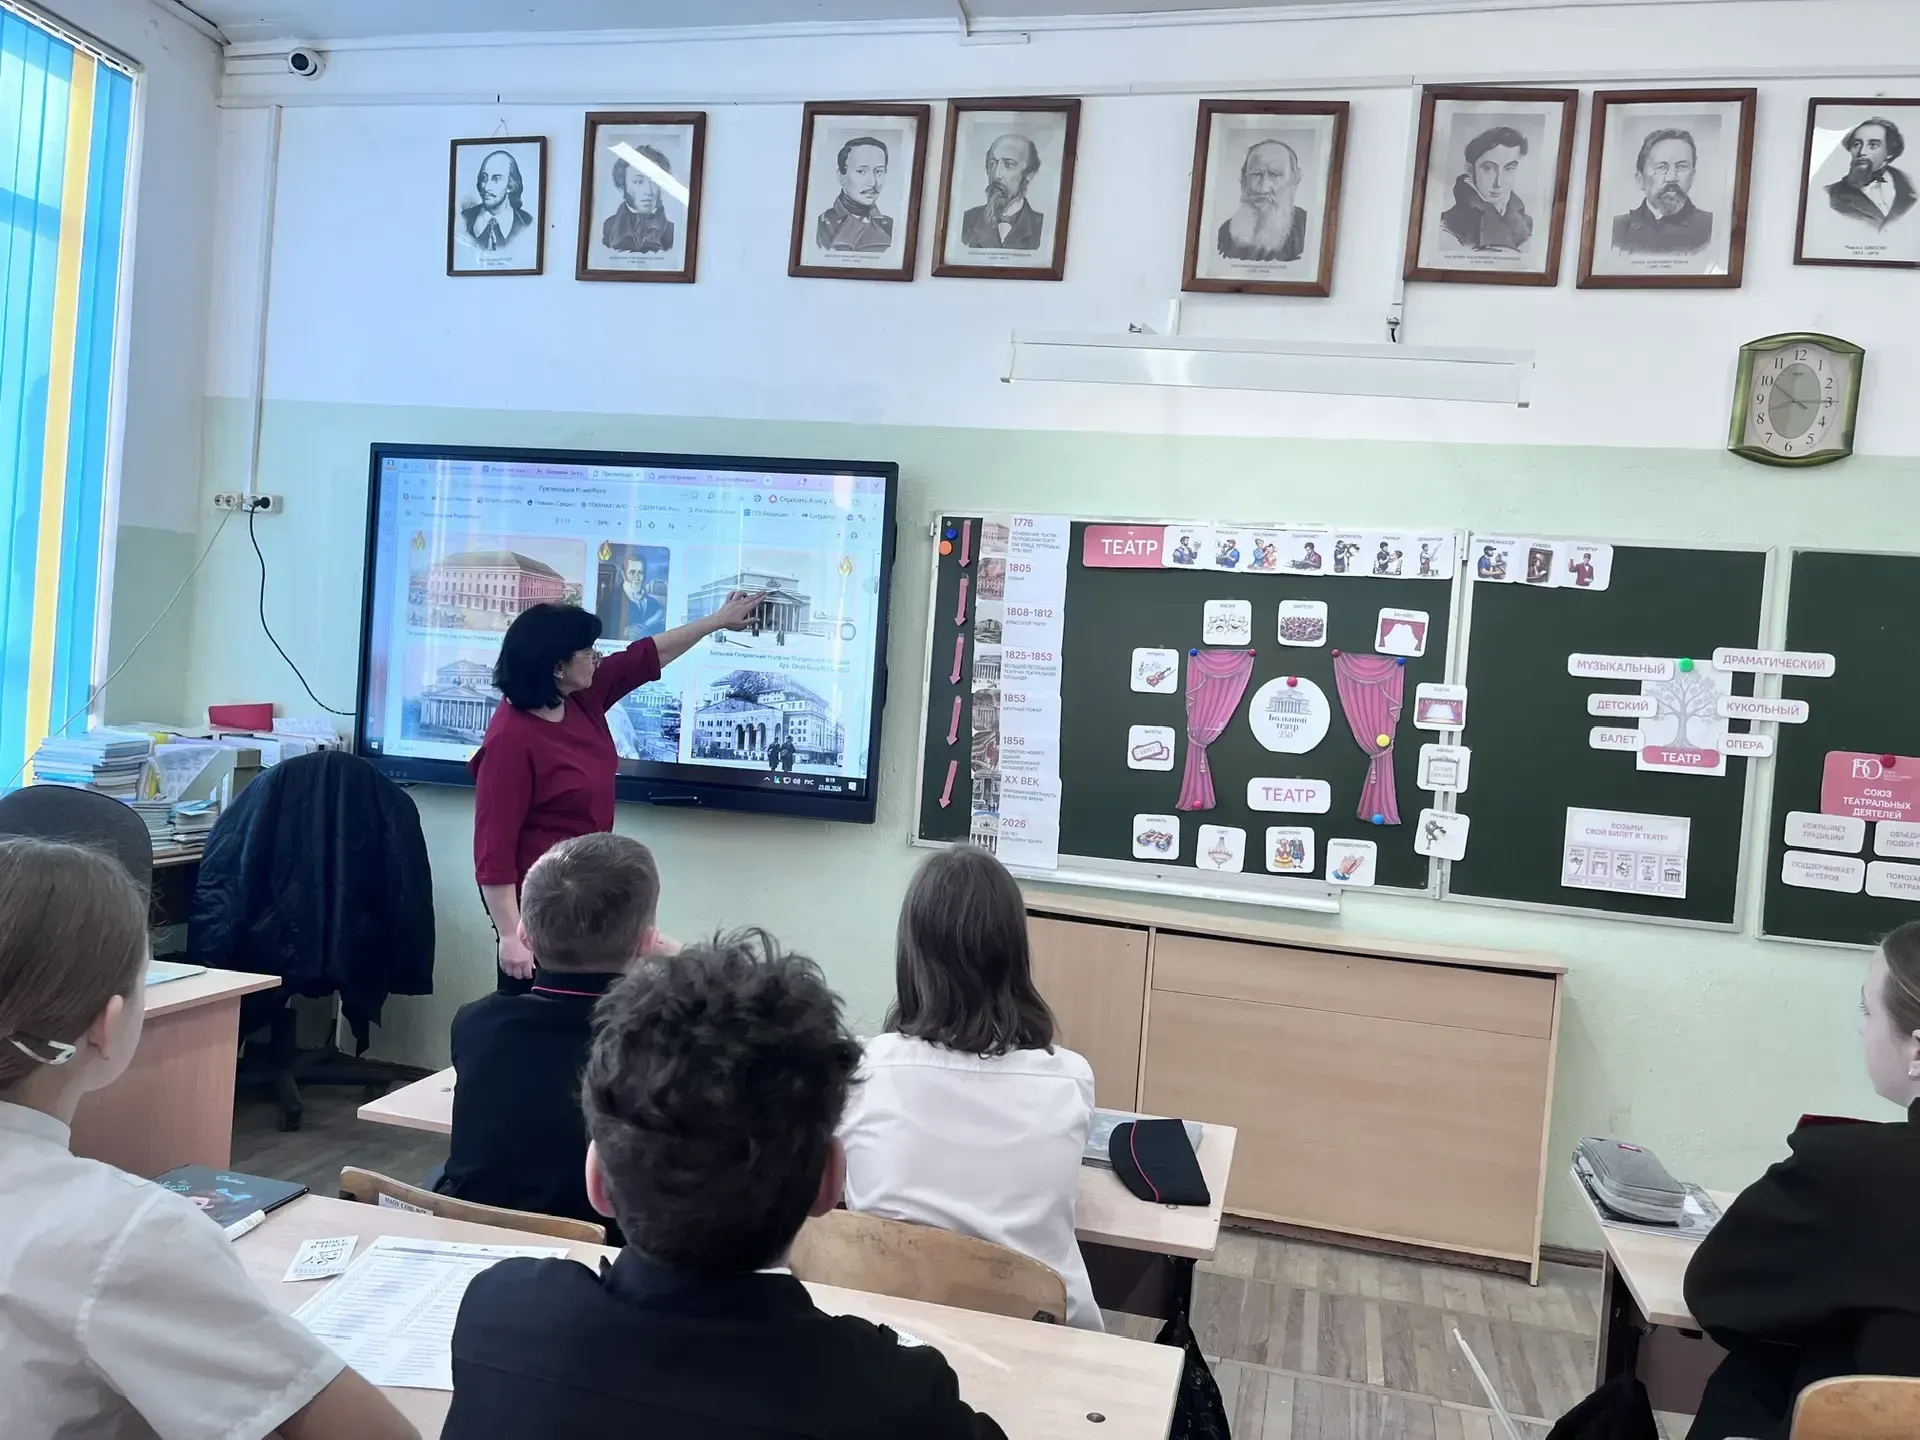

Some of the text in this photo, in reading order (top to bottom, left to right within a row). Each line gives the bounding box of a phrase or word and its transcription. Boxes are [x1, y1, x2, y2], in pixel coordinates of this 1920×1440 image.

[1794, 349, 1807, 361] 12
[1774, 358, 1784, 370] 11
[1819, 360, 1823, 371] 1
[1761, 375, 1773, 386] 10
[1825, 378, 1833, 389] 2
[1756, 394, 1764, 404] 9
[1824, 396, 1833, 409] 3
[1756, 412, 1765, 425] 8
[1818, 416, 1825, 428] 4
[1765, 432, 1773, 444] 7
[1806, 433, 1815, 445] 5
[1784, 441, 1793, 452] 6
[1014, 518, 1034, 528] 1776
[1101, 538, 1158, 556] ТЕАТР
[1009, 563, 1032, 573] 1805
[1006, 608, 1053, 618] 1808-1812
[734, 652, 767, 660] Петровский
[1005, 651, 1053, 662] 1825-1853
[1577, 660, 1666, 674] МУЗЫКАЛЬНЫЙ
[1722, 654, 1826, 670] ДРАМАТИЧЕСКИЙ
[1004, 694, 1026, 703] 1853
[1597, 700, 1649, 712] ДЕТСКИЙ
[1726, 702, 1800, 716] КУКОЛЬНЫЙ
[1268, 714, 1307, 724] Большой
[1276, 722, 1299, 732] театр
[1278, 731, 1293, 739] 250
[1600, 734, 1636, 745] БАЛЕТ
[1003, 736, 1025, 746] 1856
[1726, 740, 1764, 750] ОПЕРА
[1662, 752, 1701, 764] ТЕАТР
[1020, 776, 1040, 787] ВЕК
[1262, 786, 1316, 803] ТЕАТР
[1864, 788, 1892, 798] СОЮЗ
[1843, 796, 1911, 810] ТЕАТРАЛЬНЫХ
[1852, 808, 1902, 820] ДЕЯТЕЛЕЙ
[1002, 818, 1026, 828] 2026
[1611, 822, 1644, 831] ВОЗЬМИ
[1802, 822, 1846, 833] СОХРАНЯЕТ
[1585, 828, 1607, 836] СВОЙ
[1608, 830, 1633, 838] БИЛЕТ
[1803, 831, 1845, 842] ТРАДИЦИИ
[1886, 840, 1914, 848] ЛЮДЕЙ
[1792, 860, 1856, 875] ПОДДЕРЖИВАЕТ
